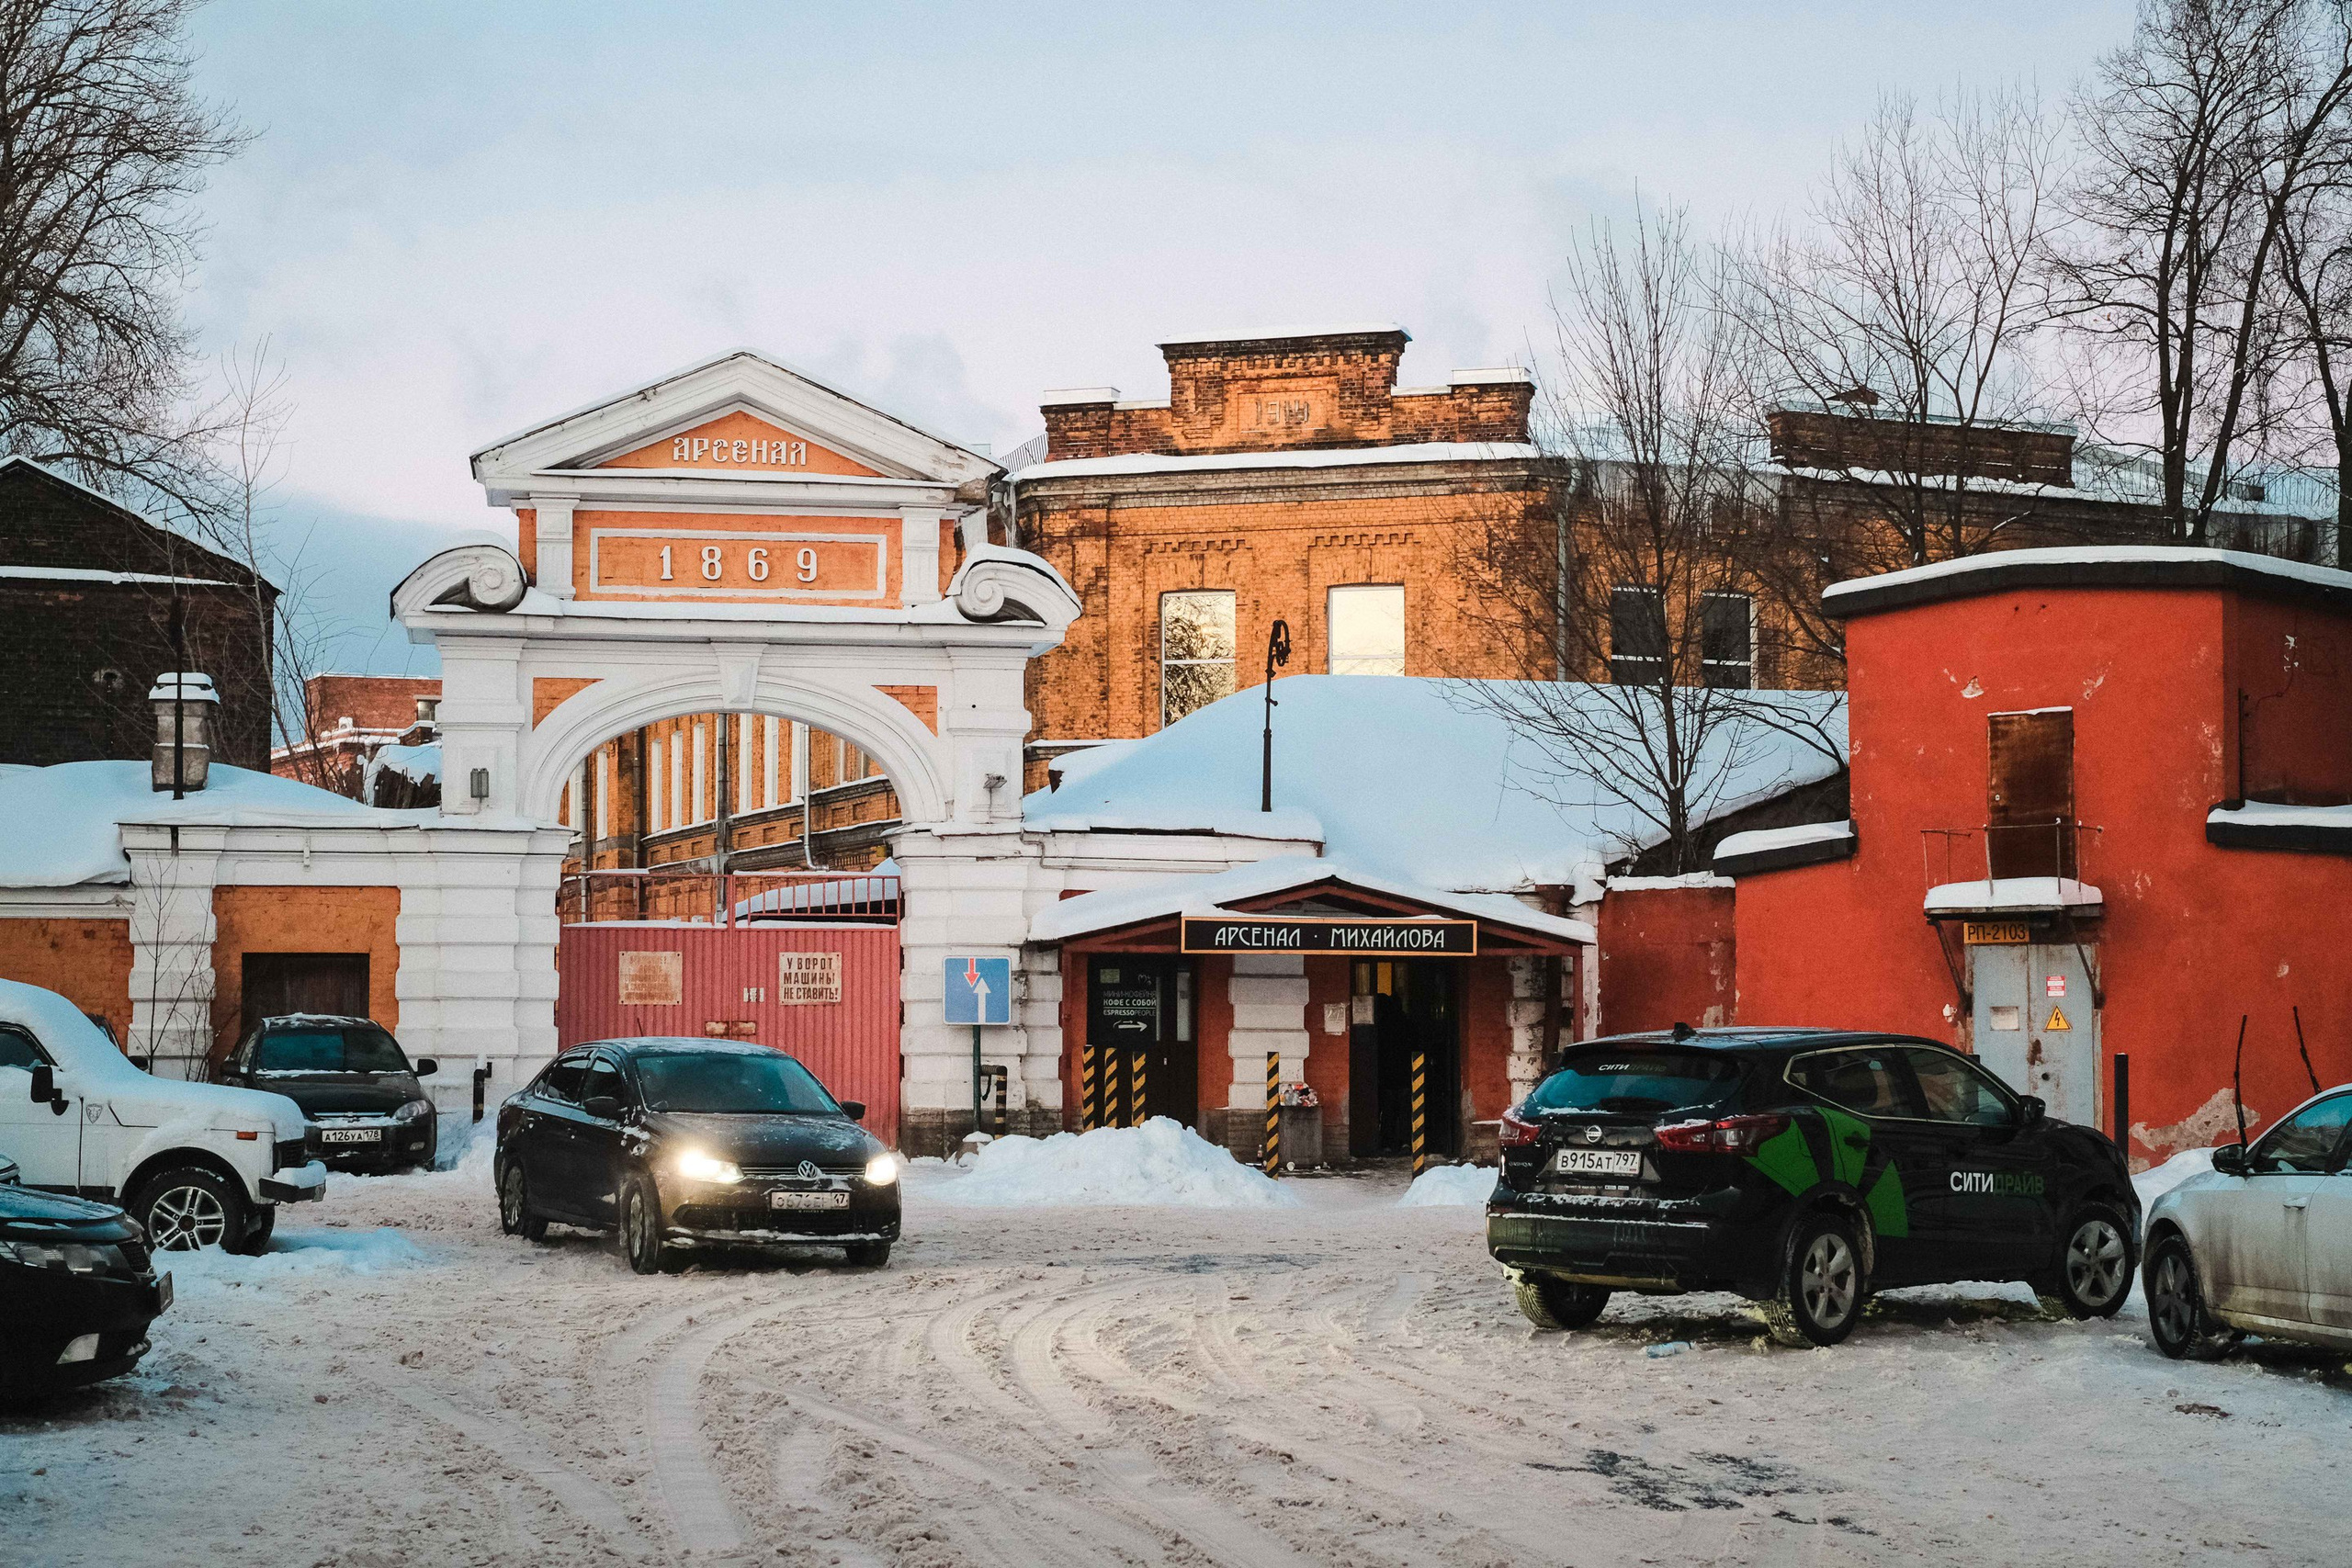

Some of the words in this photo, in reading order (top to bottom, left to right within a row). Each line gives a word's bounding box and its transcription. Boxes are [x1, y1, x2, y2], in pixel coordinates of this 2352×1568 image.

[673, 436, 807, 466] АРСЕНАЛ
[659, 545, 818, 582] 1869
[1215, 926, 1301, 947] АРСЕНАЛ
[1330, 925, 1445, 948] МИХАЙЛОВА
[1967, 923, 2027, 941] РП-2103
[786, 957, 793, 970] У
[797, 957, 833, 970] ВОРОТ
[784, 972, 835, 985] МАШИНЫ
[784, 987, 794, 999] НЕ
[796, 987, 838, 1000] СТАВИТЬ!
[1132, 997, 1157, 1007] СОБОЙ
[1615, 1153, 1635, 1166] 797
